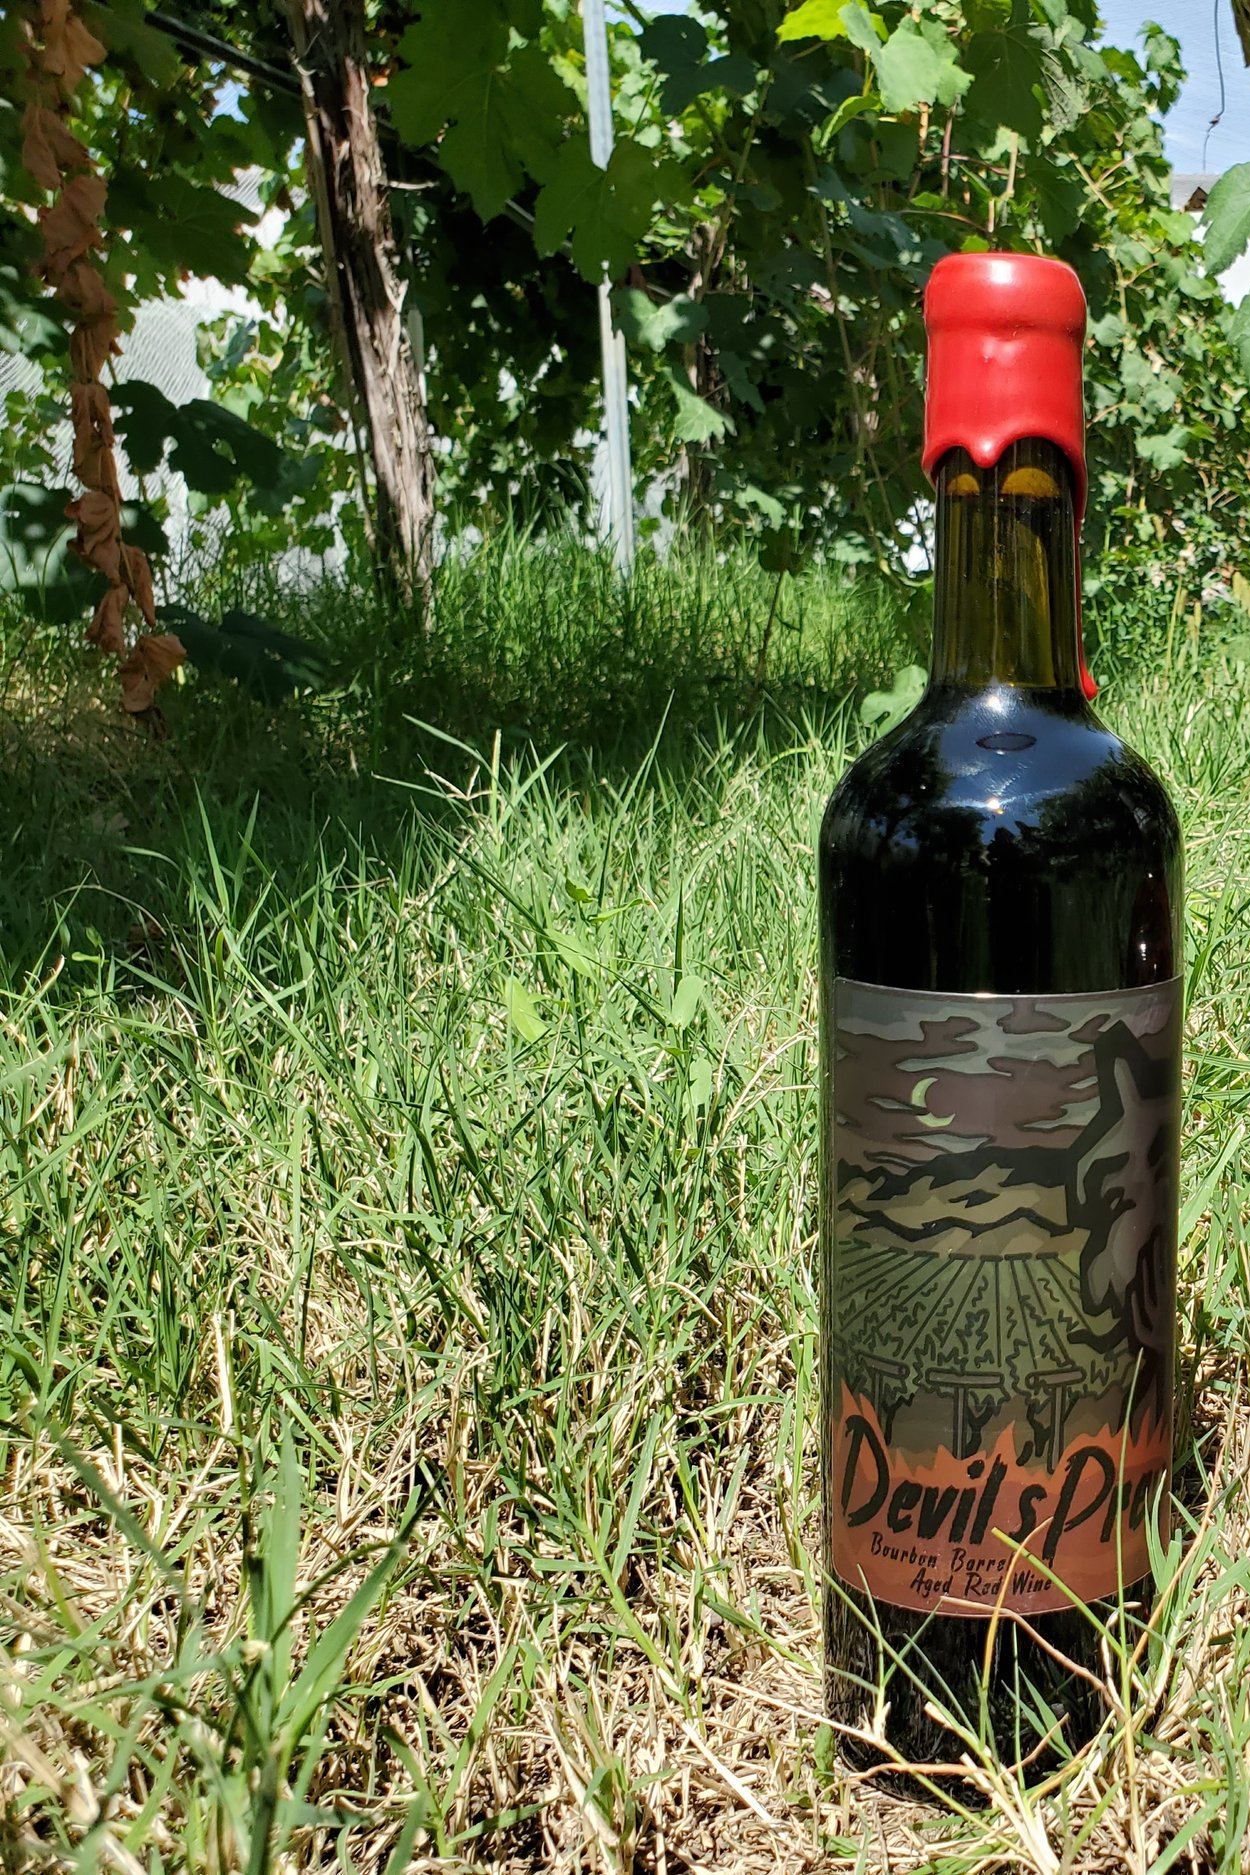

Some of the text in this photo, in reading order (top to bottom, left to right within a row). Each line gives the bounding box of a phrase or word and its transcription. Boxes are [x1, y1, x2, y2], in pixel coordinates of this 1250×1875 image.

[843, 1414, 1048, 1546] Devil's
[870, 1531, 938, 1568] Bourbon
[910, 1567, 953, 1598] Aged
[1012, 1570, 1051, 1596] Wine
